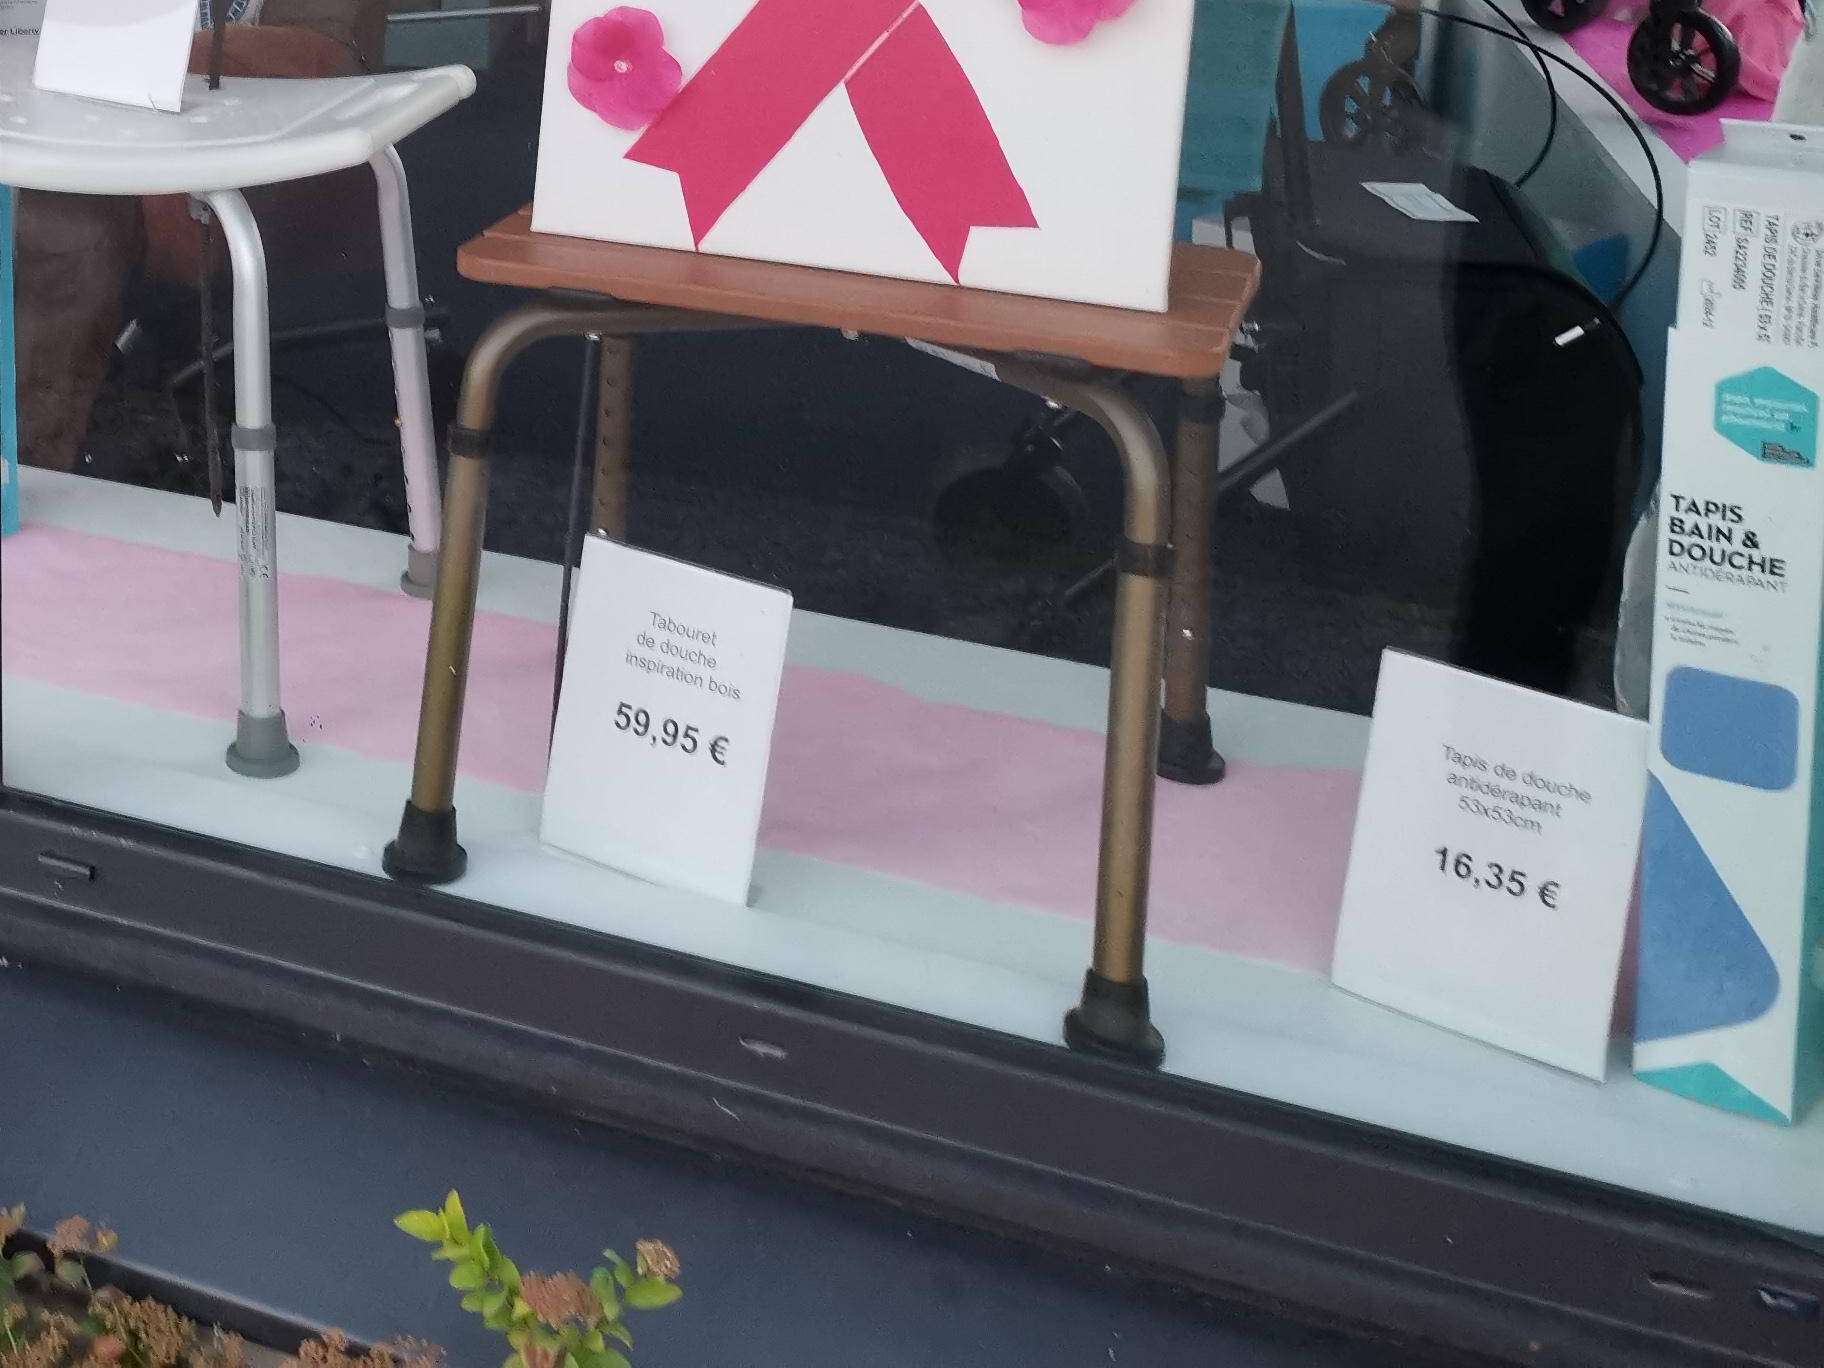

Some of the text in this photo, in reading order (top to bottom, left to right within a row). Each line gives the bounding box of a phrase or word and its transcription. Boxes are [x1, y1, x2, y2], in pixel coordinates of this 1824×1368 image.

[1708, 209, 1722, 232] LOT
[1739, 211, 1754, 234] REF
[1670, 493, 1744, 524] TAPIS
[1669, 516, 1760, 550] BAIN &
[1668, 538, 1786, 578] DOUCHE
[1668, 561, 1788, 593] ANTIDÉRAPANT
[650, 611, 718, 648] Tabouret
[636, 632, 717, 669] de douche
[625, 649, 742, 701] inspiration bois
[614, 701, 730, 767] 59,95 €
[1442, 744, 1593, 804] Tapis de douche
[1446, 772, 1563, 819] antidérapant
[1458, 795, 1543, 835] 53x53cm
[1434, 846, 1562, 912] 16,35 €
